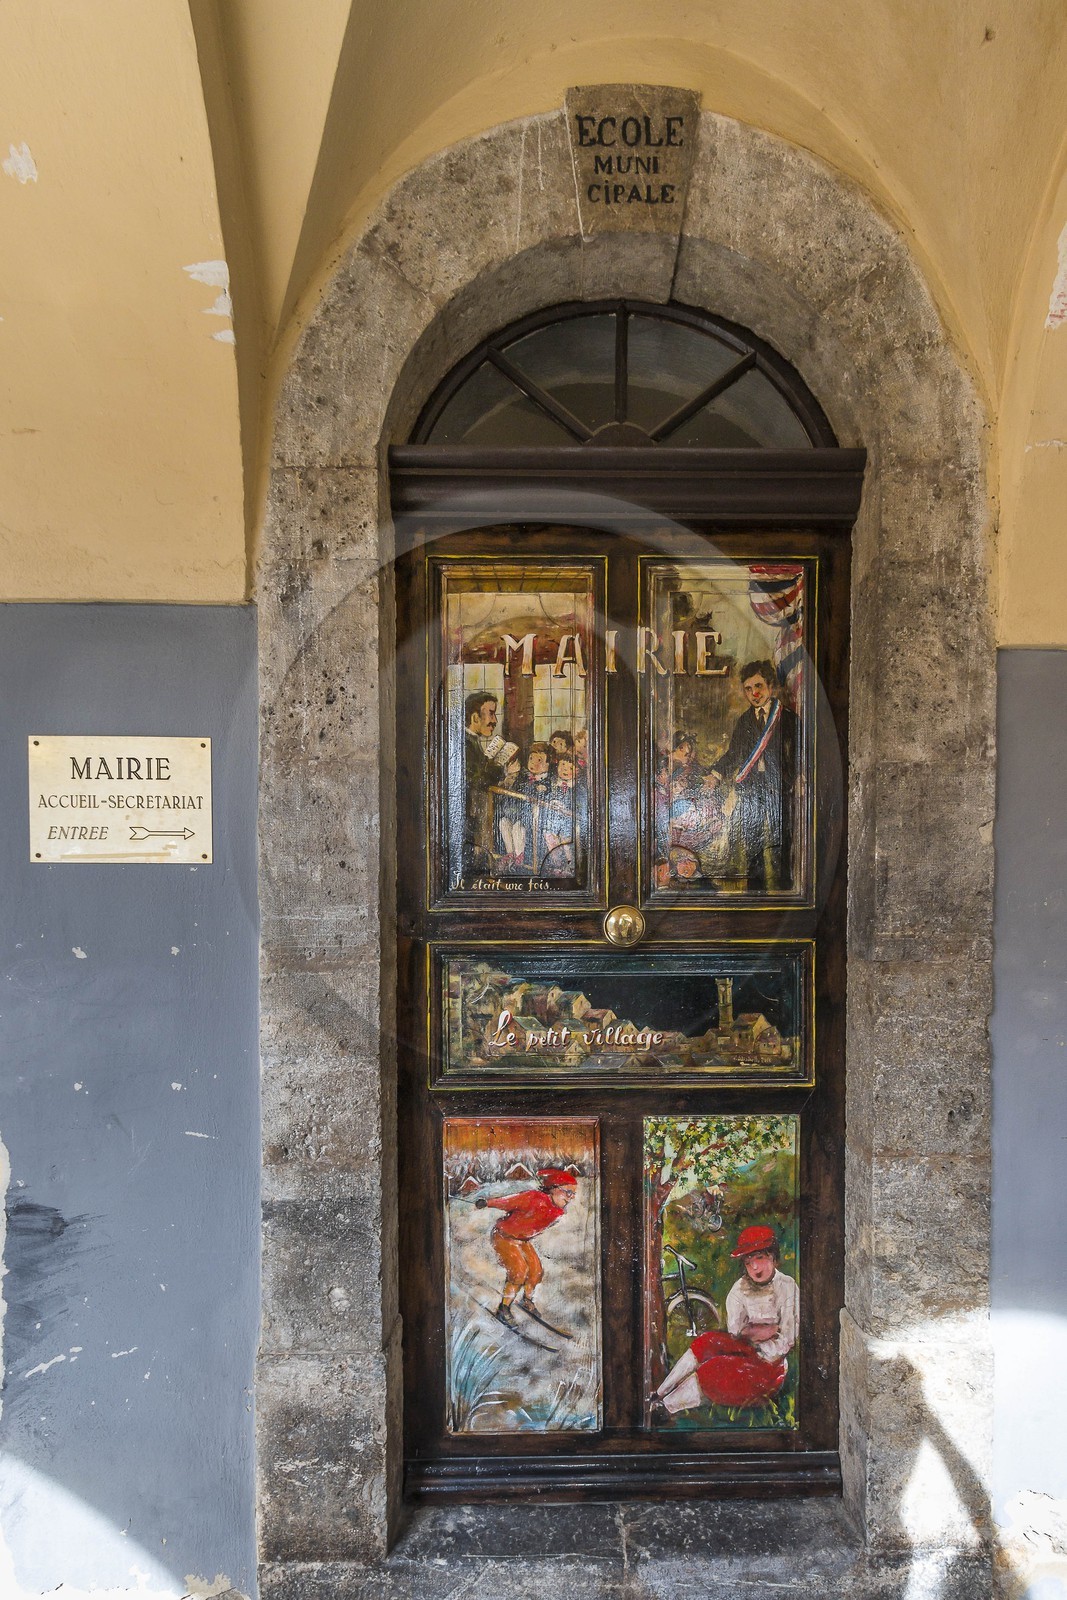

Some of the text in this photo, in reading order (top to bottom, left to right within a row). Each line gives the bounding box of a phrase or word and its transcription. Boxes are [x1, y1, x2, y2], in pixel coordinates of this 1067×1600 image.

[575, 114, 684, 147] ECOLE
[594, 155, 660, 175] MUNI
[501, 626, 730, 678] MAIRIE
[69, 757, 171, 780] MAIRIE
[38, 795, 203, 809] ACCUEIL-SECRETARIAT
[47, 826, 109, 840] ENTREE
[471, 879, 501, 890] était
[489, 1010, 663, 1051] Le petit village
